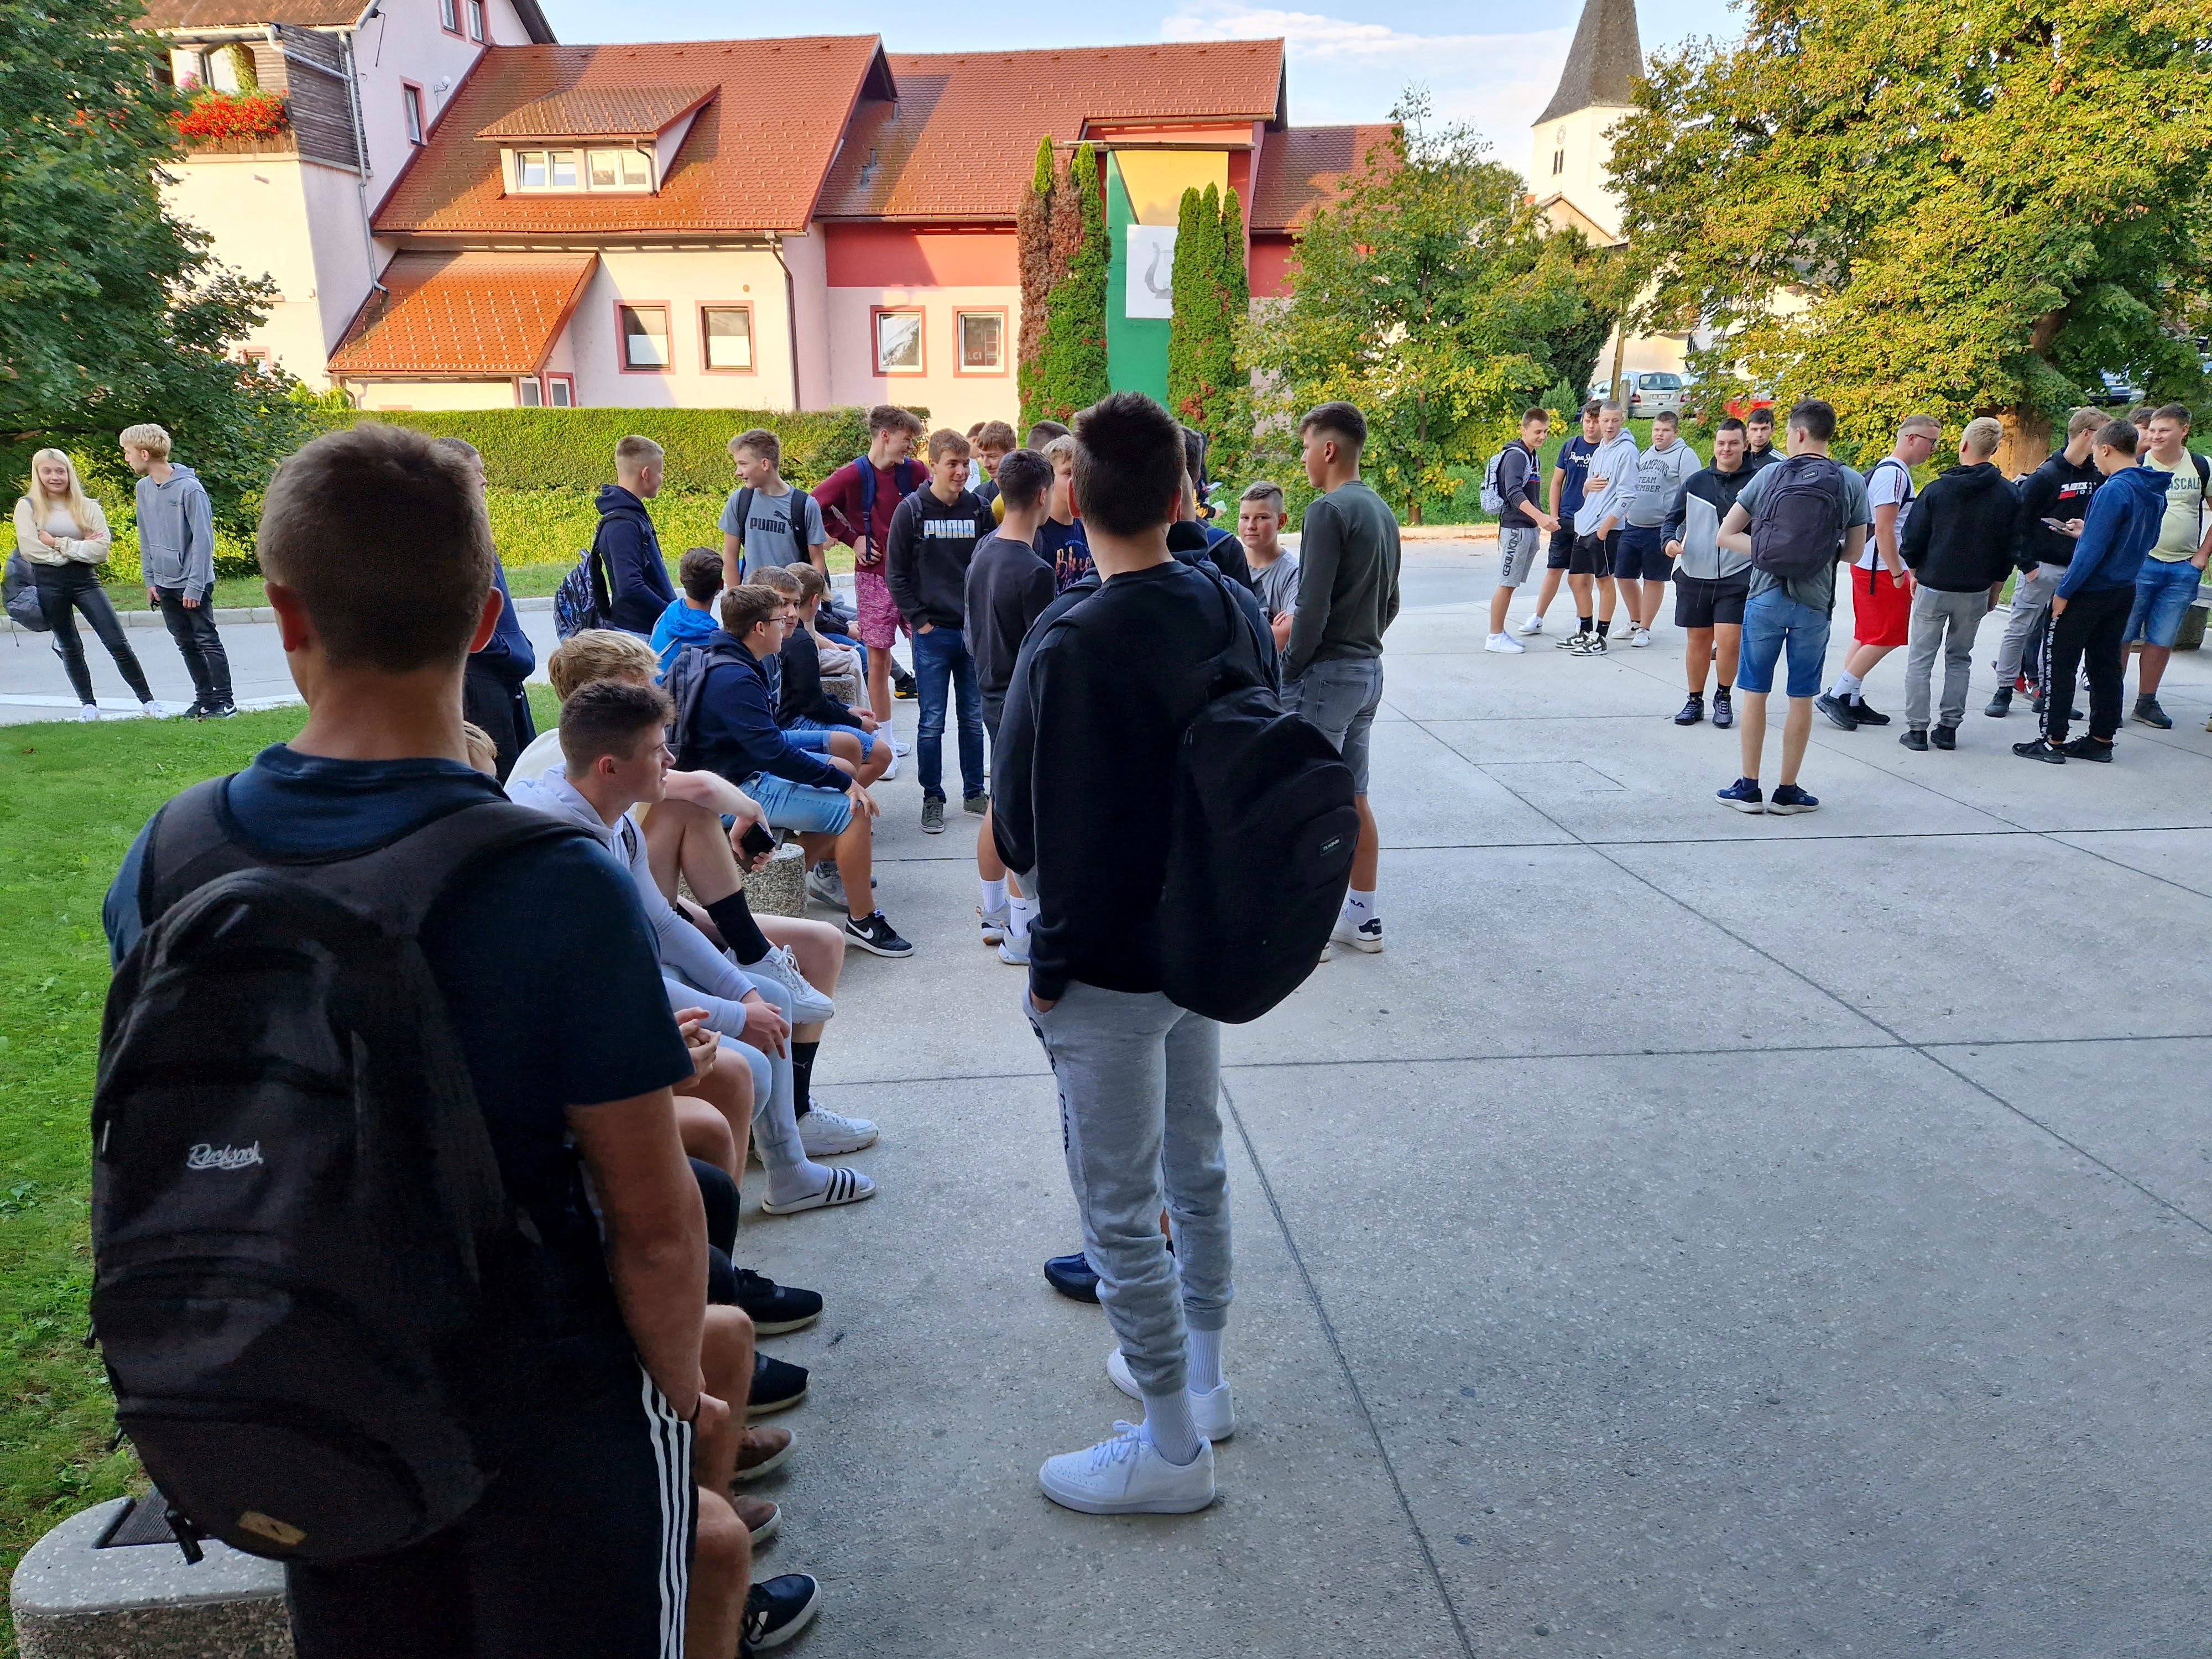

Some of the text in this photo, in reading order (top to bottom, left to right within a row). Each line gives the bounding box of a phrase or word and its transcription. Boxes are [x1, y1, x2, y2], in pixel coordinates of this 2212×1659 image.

[750, 517, 786, 534] PUMA
[924, 519, 975, 539] PUMA
[1349, 898, 1365, 908] ILA
